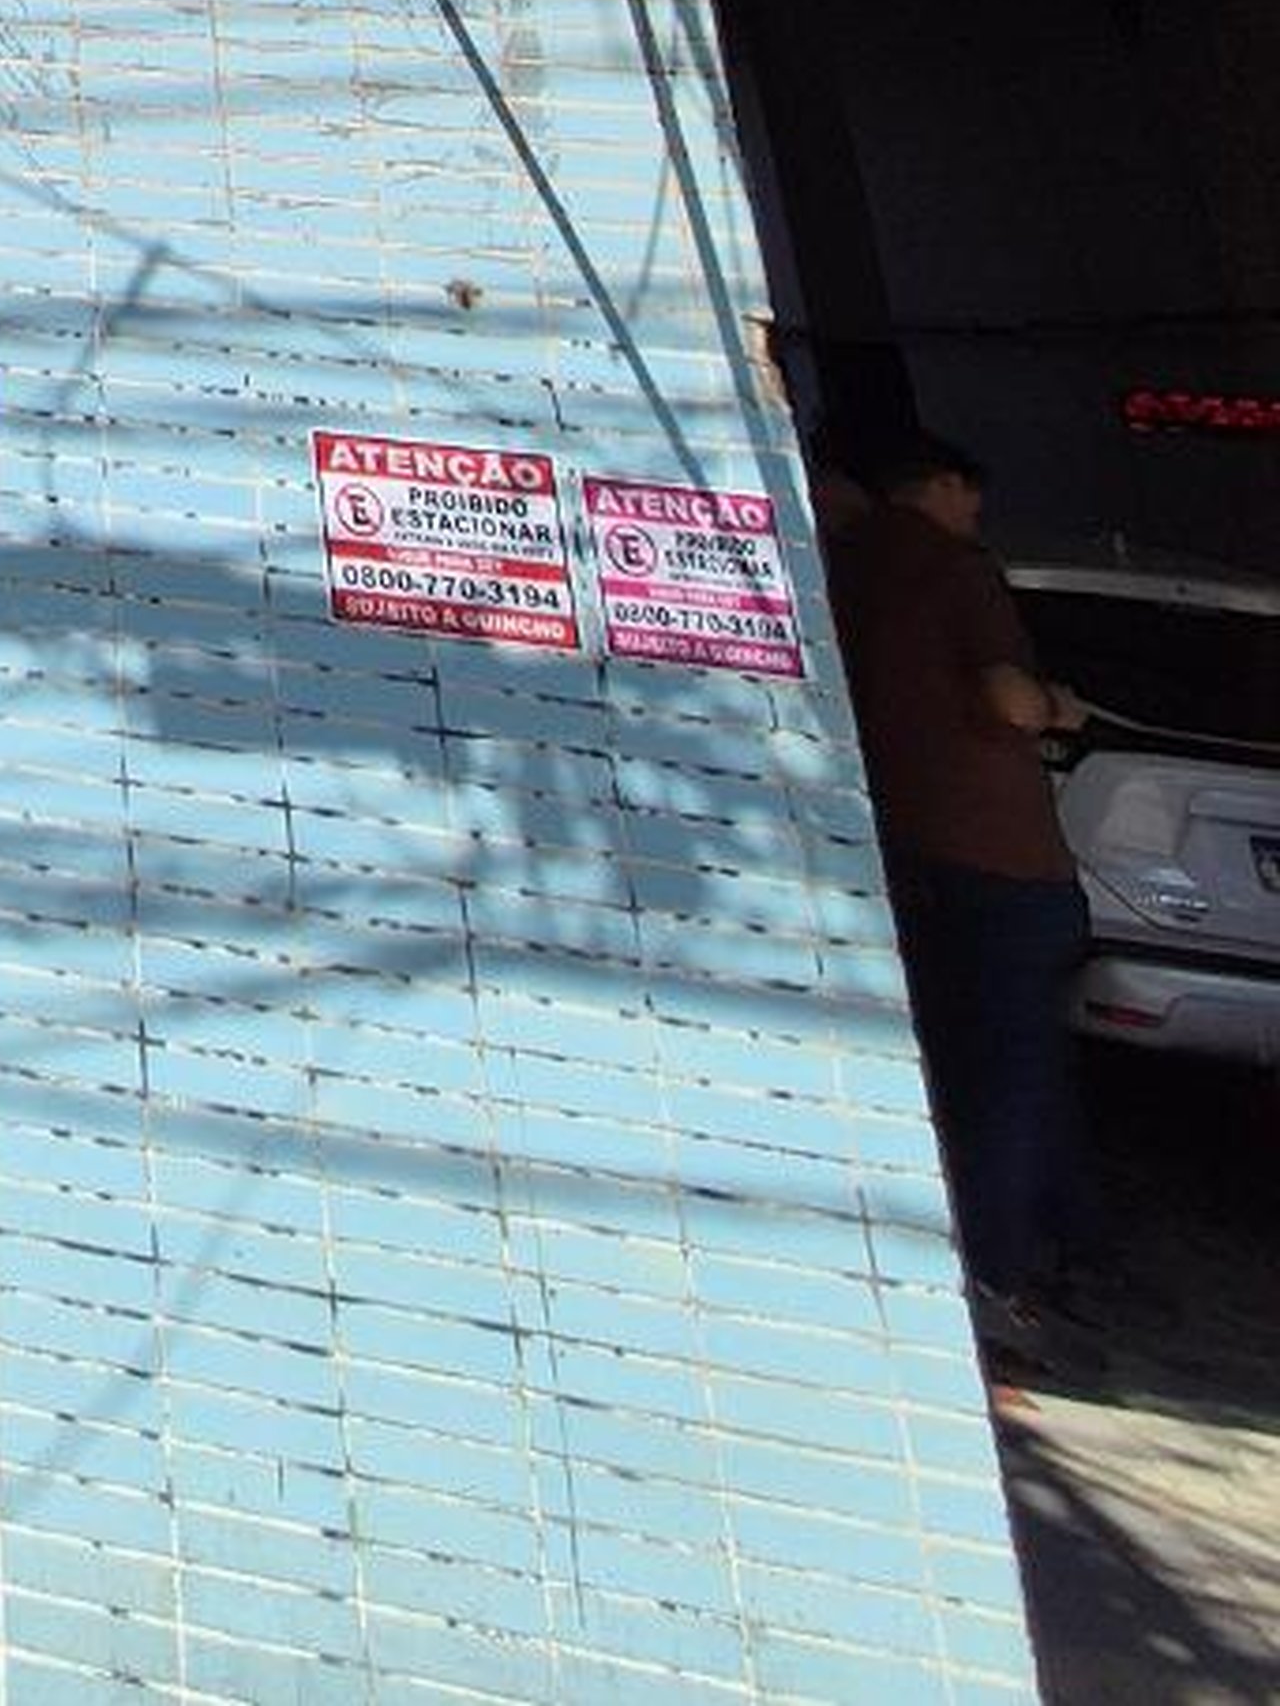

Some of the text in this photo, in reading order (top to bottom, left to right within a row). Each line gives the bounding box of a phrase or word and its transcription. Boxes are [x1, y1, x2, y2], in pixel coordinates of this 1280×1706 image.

[329, 440, 543, 491] ATENÇÃO
[390, 507, 553, 544] ESTACIONAR
[408, 486, 529, 519] PROIBIDO
[596, 486, 769, 532] ATENÇÃO
[342, 563, 561, 609] 0800-770-3194
